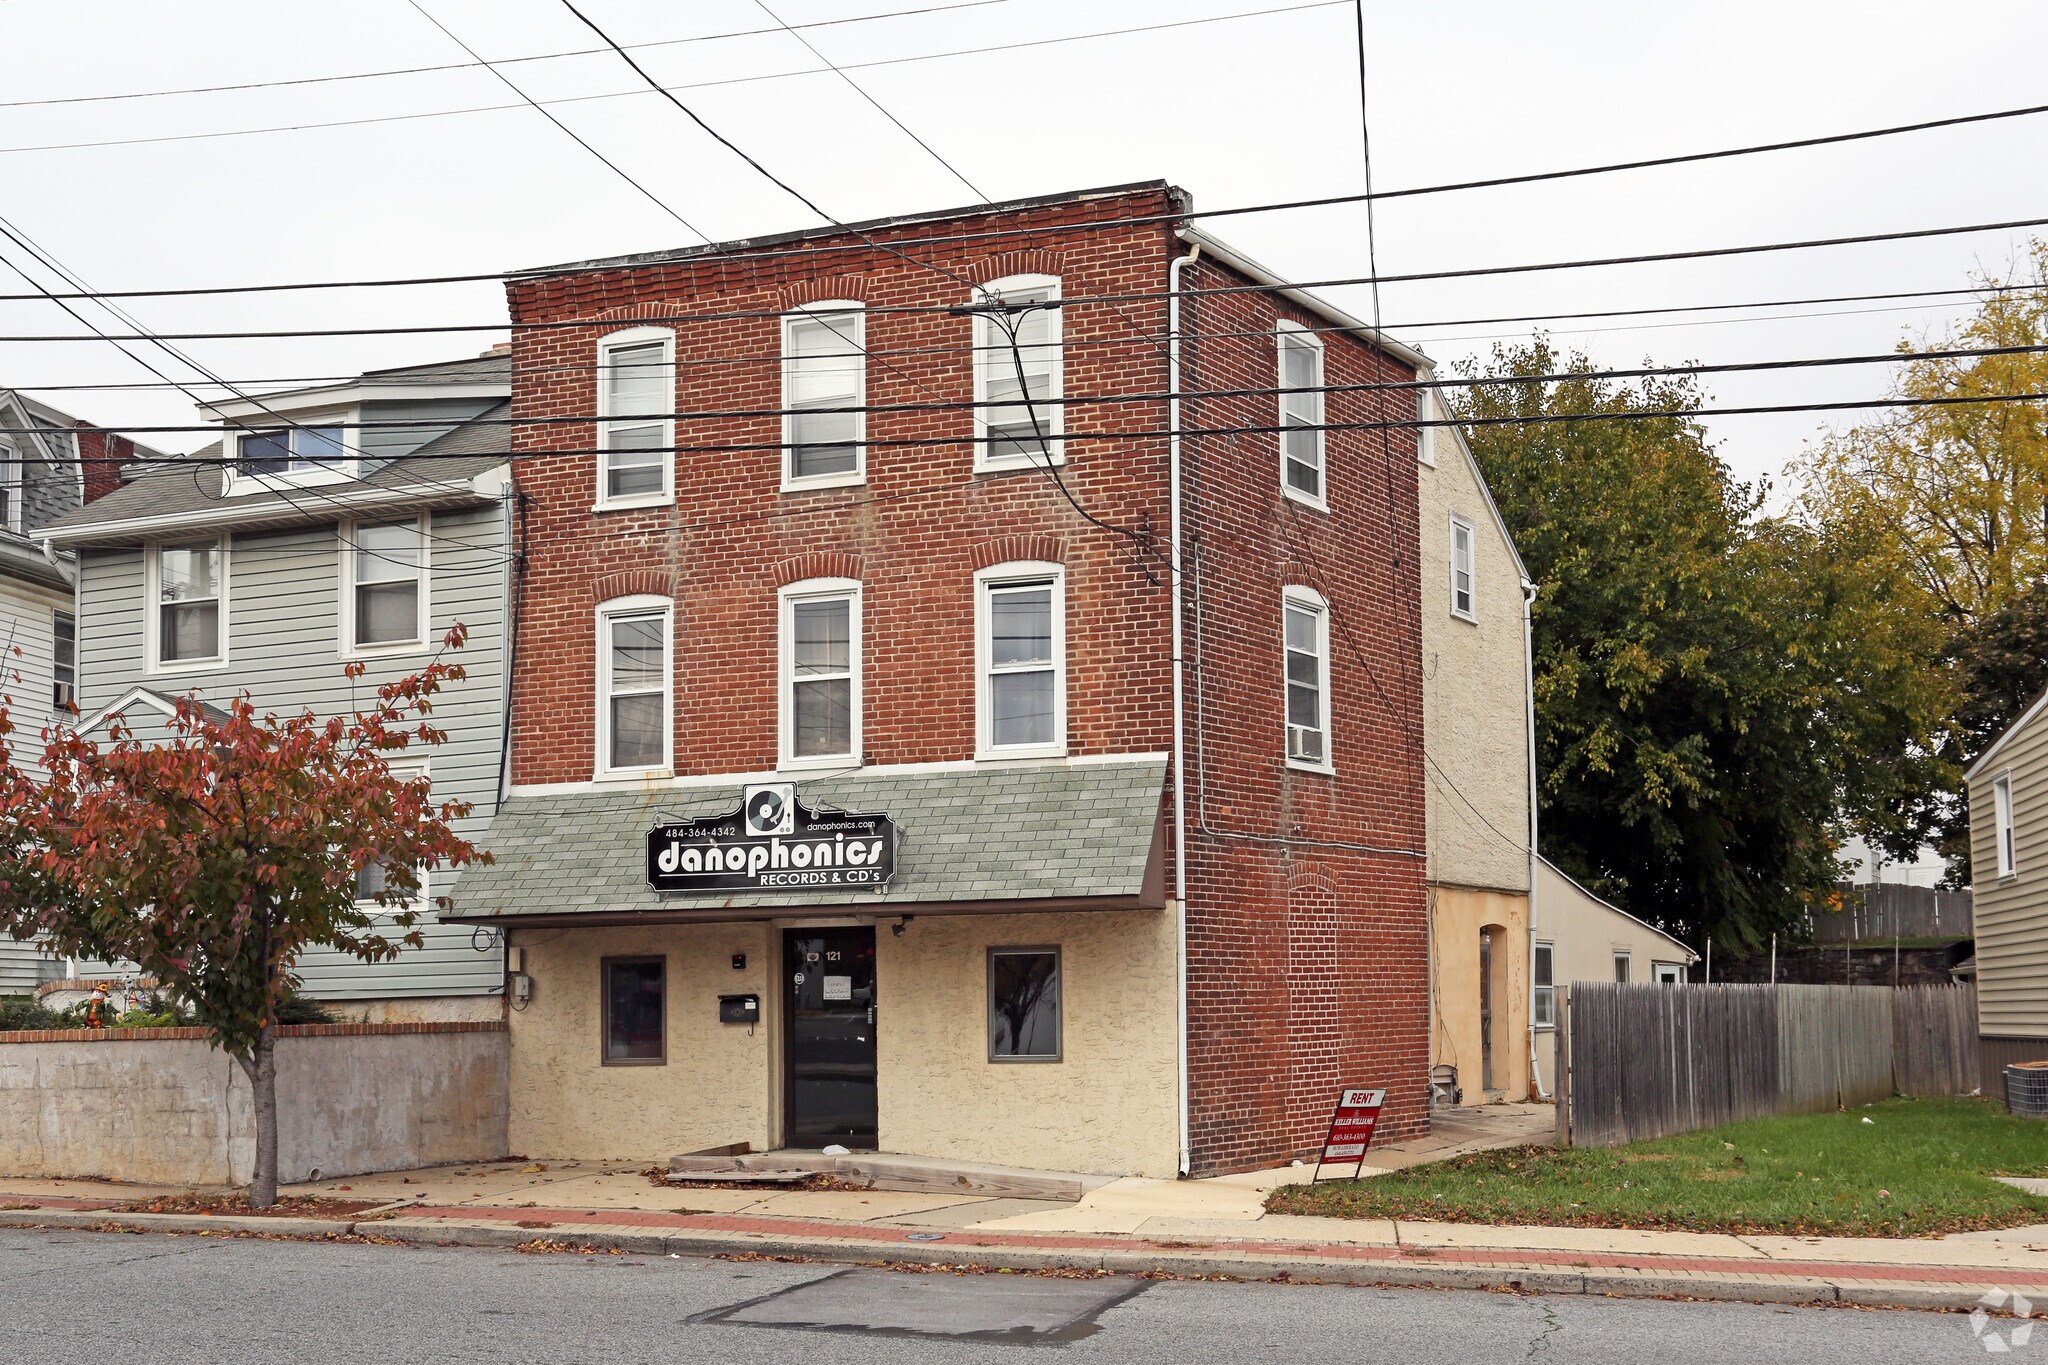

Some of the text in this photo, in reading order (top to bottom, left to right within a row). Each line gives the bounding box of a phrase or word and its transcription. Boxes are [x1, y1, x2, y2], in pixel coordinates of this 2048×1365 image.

[806, 820, 876, 832] danophonics.com
[665, 827, 736, 838] 484-364-4342
[657, 832, 883, 878] danophonics
[760, 869, 880, 886] RECORDS & CD's
[826, 951, 841, 961] 121
[1350, 1093, 1374, 1104] RENT
[1334, 1118, 1352, 1126] KELLER
